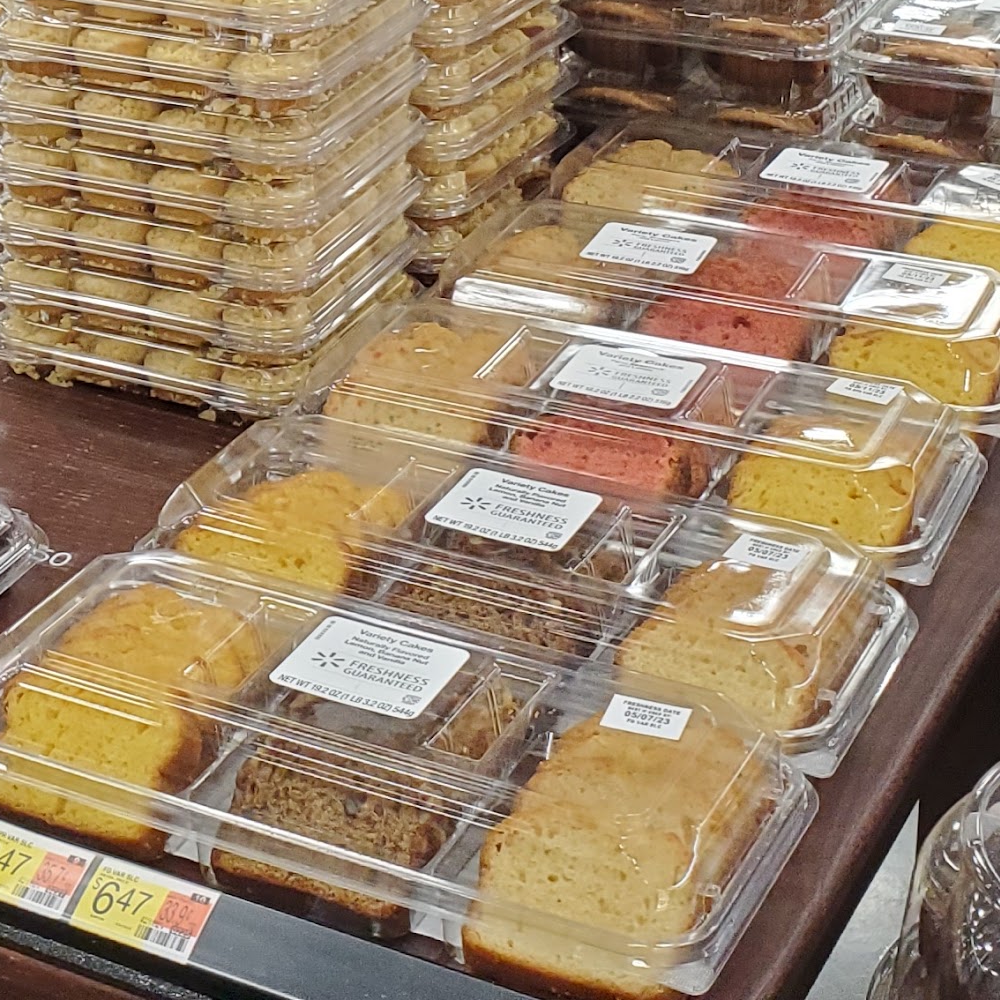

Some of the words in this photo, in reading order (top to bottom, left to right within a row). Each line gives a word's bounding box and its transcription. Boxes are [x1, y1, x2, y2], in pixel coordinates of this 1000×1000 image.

[620, 227, 660, 237] Variety
[662, 233, 697, 242] Cakes
[599, 350, 642, 363] Variety
[644, 359, 684, 370] Cakes
[611, 375, 669, 388] GUARANTEED
[614, 371, 671, 384] FRESHNESS
[495, 483, 530, 497] Naturally
[531, 491, 567, 503] Flavored
[501, 477, 536, 491] Variety
[538, 486, 569, 498] Cakes
[519, 498, 546, 508] Vanilla
[520, 494, 550, 504] Banana
[551, 499, 567, 508] Nut
[490, 509, 564, 530] GUARANTEED
[494, 503, 568, 525] FRESHNESS
[433, 514, 448, 523] NET
[449, 519, 463, 527] WT
[463, 522, 479, 531] 19.2
[479, 526, 491, 535] OZ
[499, 531, 511, 539] LB
[511, 534, 524, 542] 3.2
[524, 537, 538, 546] OZ)
[538, 540, 558, 549] 544g
[748, 546, 789, 560] 05/07/23
[351, 635, 391, 651] Naturally
[391, 646, 431, 660] Flavored
[360, 629, 397, 644] Variety
[399, 640, 434, 653] Cakes
[358, 650, 376, 659] and
[376, 653, 406, 666] Vanilla
[377, 649, 412, 662] Banana
[412, 656, 429, 666] Nut
[343, 667, 423, 693] GUARANTEED
[349, 659, 431, 686] FRESHNESS
[277, 673, 297, 684] NET
[297, 678, 313, 689] WT
[312, 682, 328, 694] 19.2
[328, 688, 342, 699] OZ
[350, 695, 363, 705] LB
[362, 698, 377, 707] 3.2
[377, 702, 393, 712] OZ)
[393, 706, 416, 718] 544g
[623, 700, 661, 712] FRESHNESS
[663, 708, 681, 716] DATE
[624, 710, 670, 725] 05/07/23
[20, 838, 34, 848] SLC
[112, 869, 127, 878] VAR
[126, 874, 140, 883] SLC
